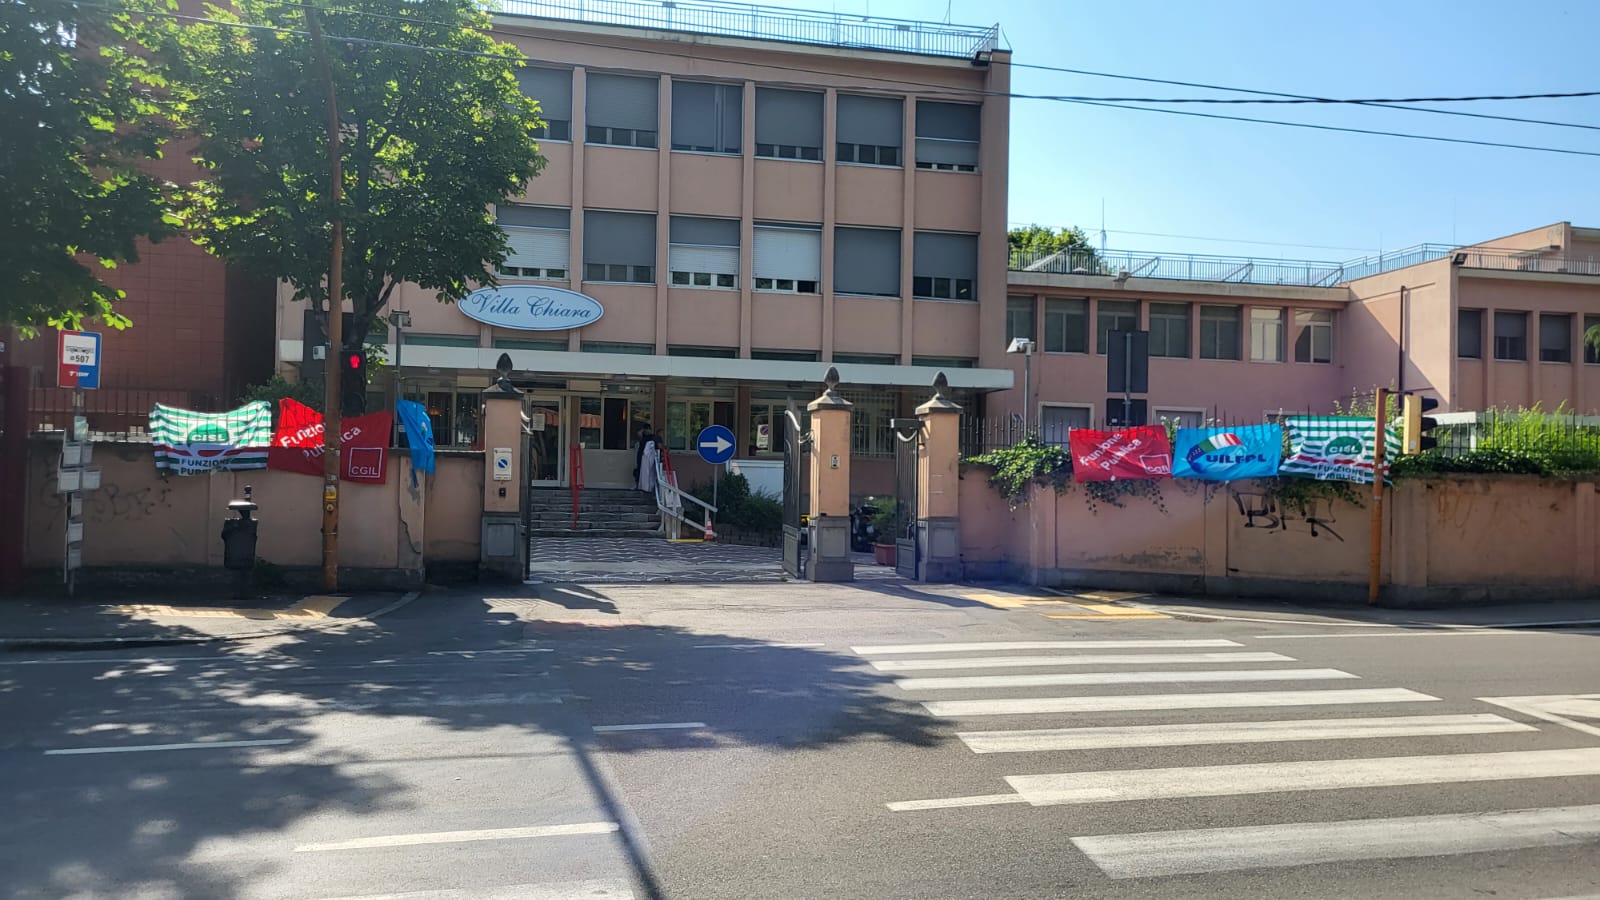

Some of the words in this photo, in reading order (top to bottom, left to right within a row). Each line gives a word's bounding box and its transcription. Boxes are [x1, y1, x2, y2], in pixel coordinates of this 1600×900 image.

[471, 293, 521, 314] Villa
[526, 295, 592, 319] Chiara
[75, 355, 90, 363] 507
[191, 433, 224, 442] CISL
[280, 423, 326, 449] Funzio
[1206, 453, 1268, 465] UILFPL
[351, 466, 379, 475] CGIL
